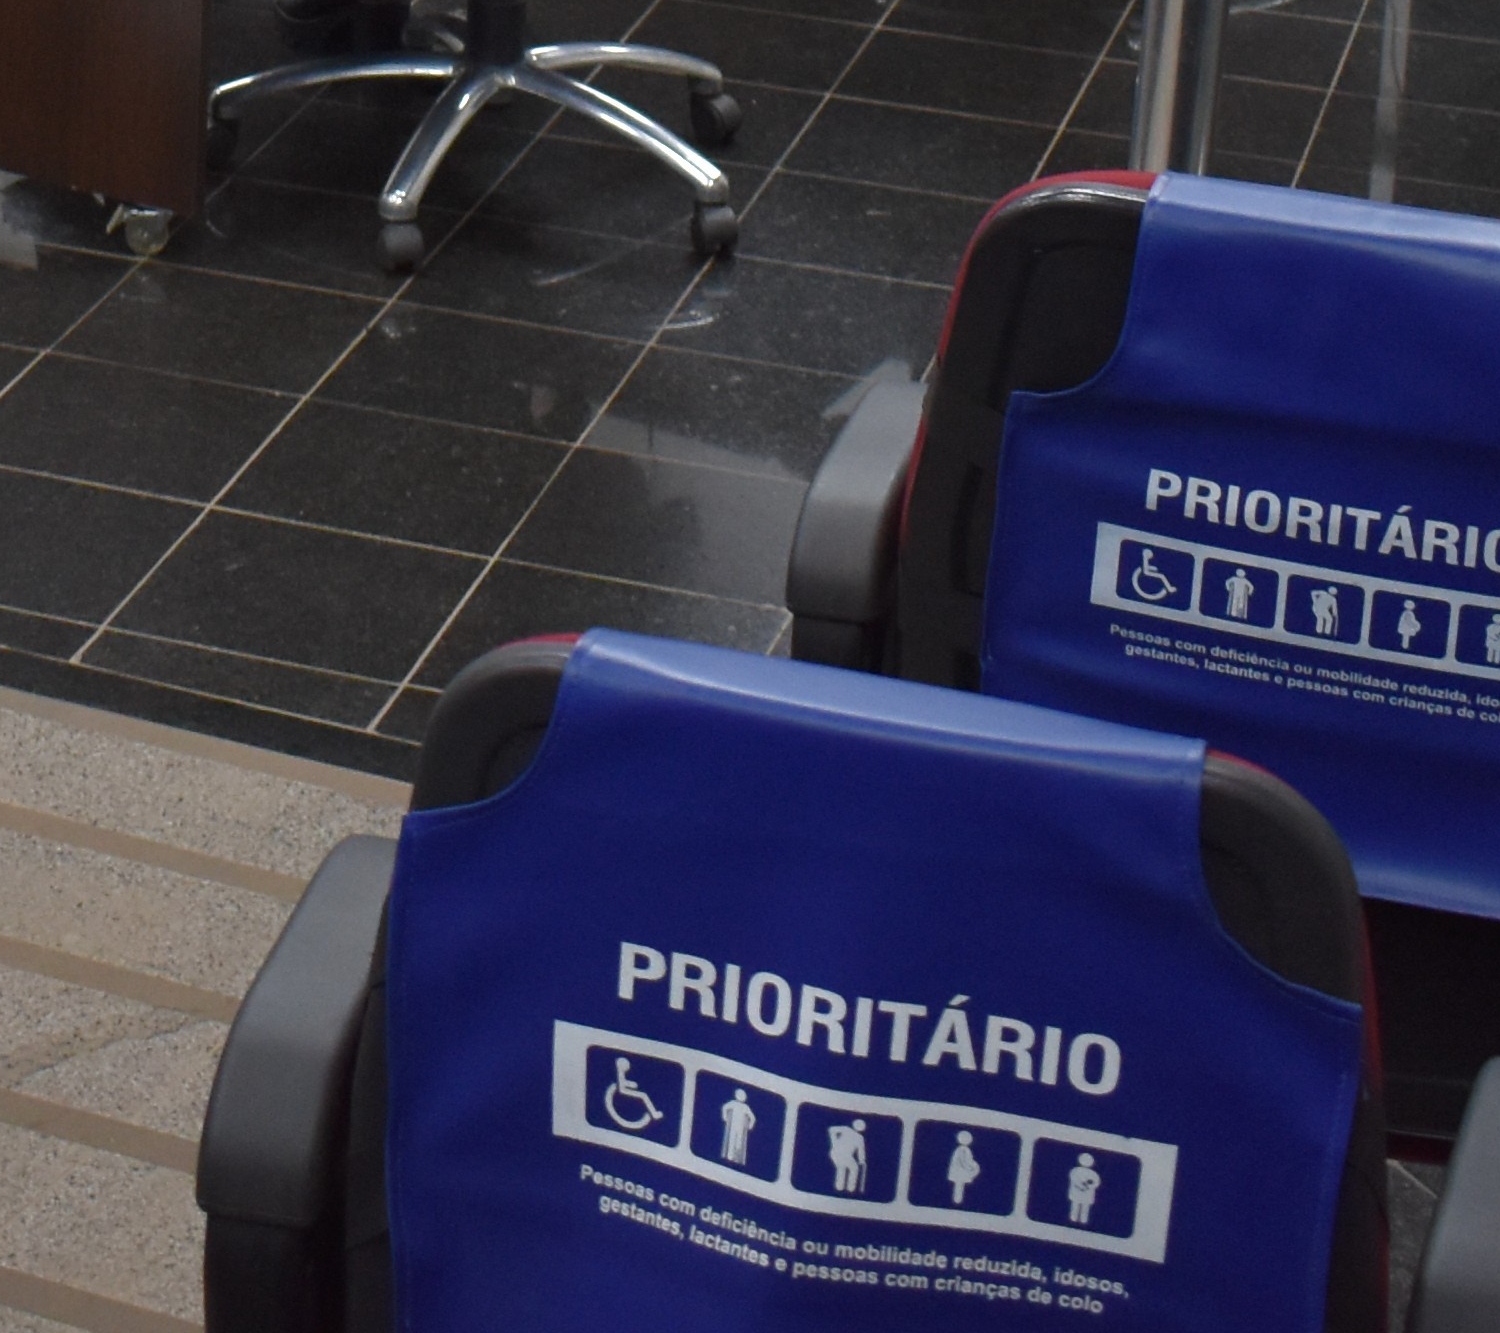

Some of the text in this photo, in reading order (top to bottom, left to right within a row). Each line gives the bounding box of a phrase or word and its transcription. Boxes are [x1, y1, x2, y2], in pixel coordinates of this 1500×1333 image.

[1110, 624, 1171, 647] Pessoas
[1175, 640, 1207, 654] com
[1210, 645, 1289, 671] deficiência
[1293, 664, 1313, 675] ou
[1317, 668, 1399, 691] mobilidade
[1403, 683, 1472, 705] reduzida,
[1125, 643, 1200, 669] gestantes,
[1204, 659, 1270, 682] lactantes
[1274, 674, 1284, 684] e
[1287, 676, 1348, 697] pessoas
[1353, 690, 1384, 703] com
[1389, 694, 1452, 715] crianças
[1457, 707, 1475, 719] de
[616, 940, 1124, 1096] PRIORITÁRIO
[580, 1164, 1129, 1298] Pessoas com deficiência ou mobilidade reduzida, idosos,
[599, 1194, 1103, 1314] gestantes, lactantes e pessoas com crianças de colo
